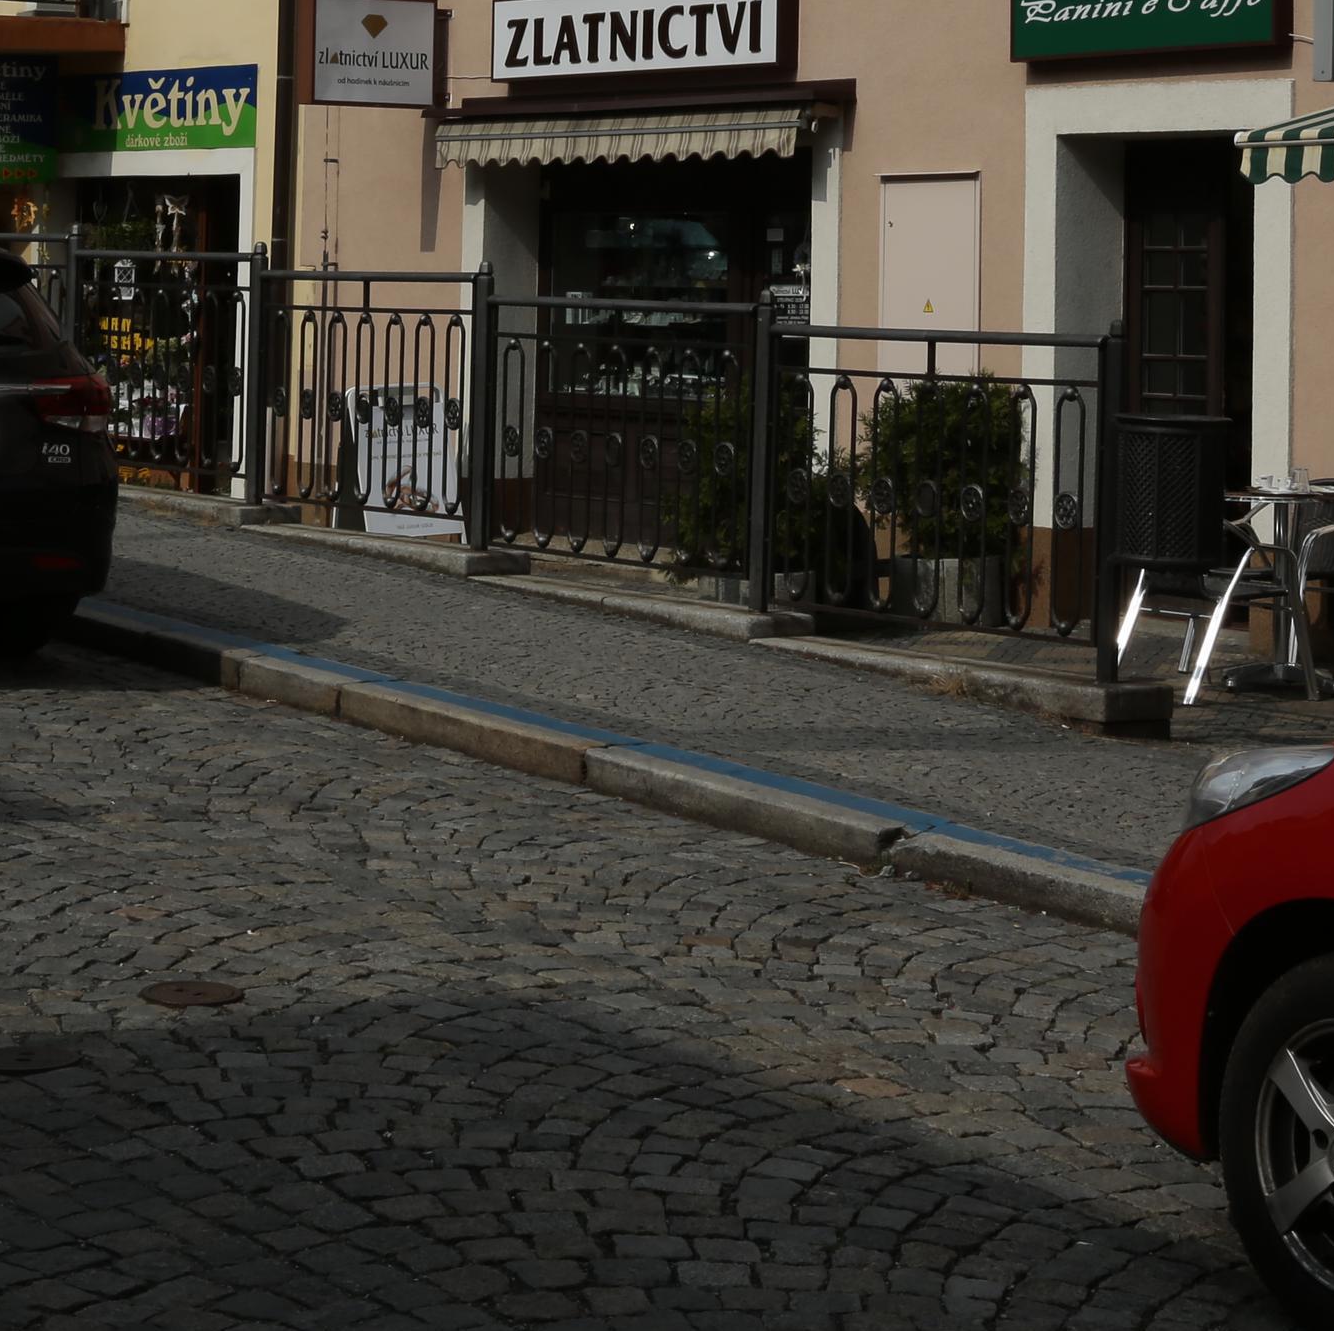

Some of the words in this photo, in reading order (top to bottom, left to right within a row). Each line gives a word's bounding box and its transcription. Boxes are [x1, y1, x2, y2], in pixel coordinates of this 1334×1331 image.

[382, 51, 429, 70] LUXUR
[92, 76, 250, 136] Květiny
[125, 133, 161, 148] dárkové
[163, 132, 187, 147] zboží
[42, 442, 70, 456] i40
